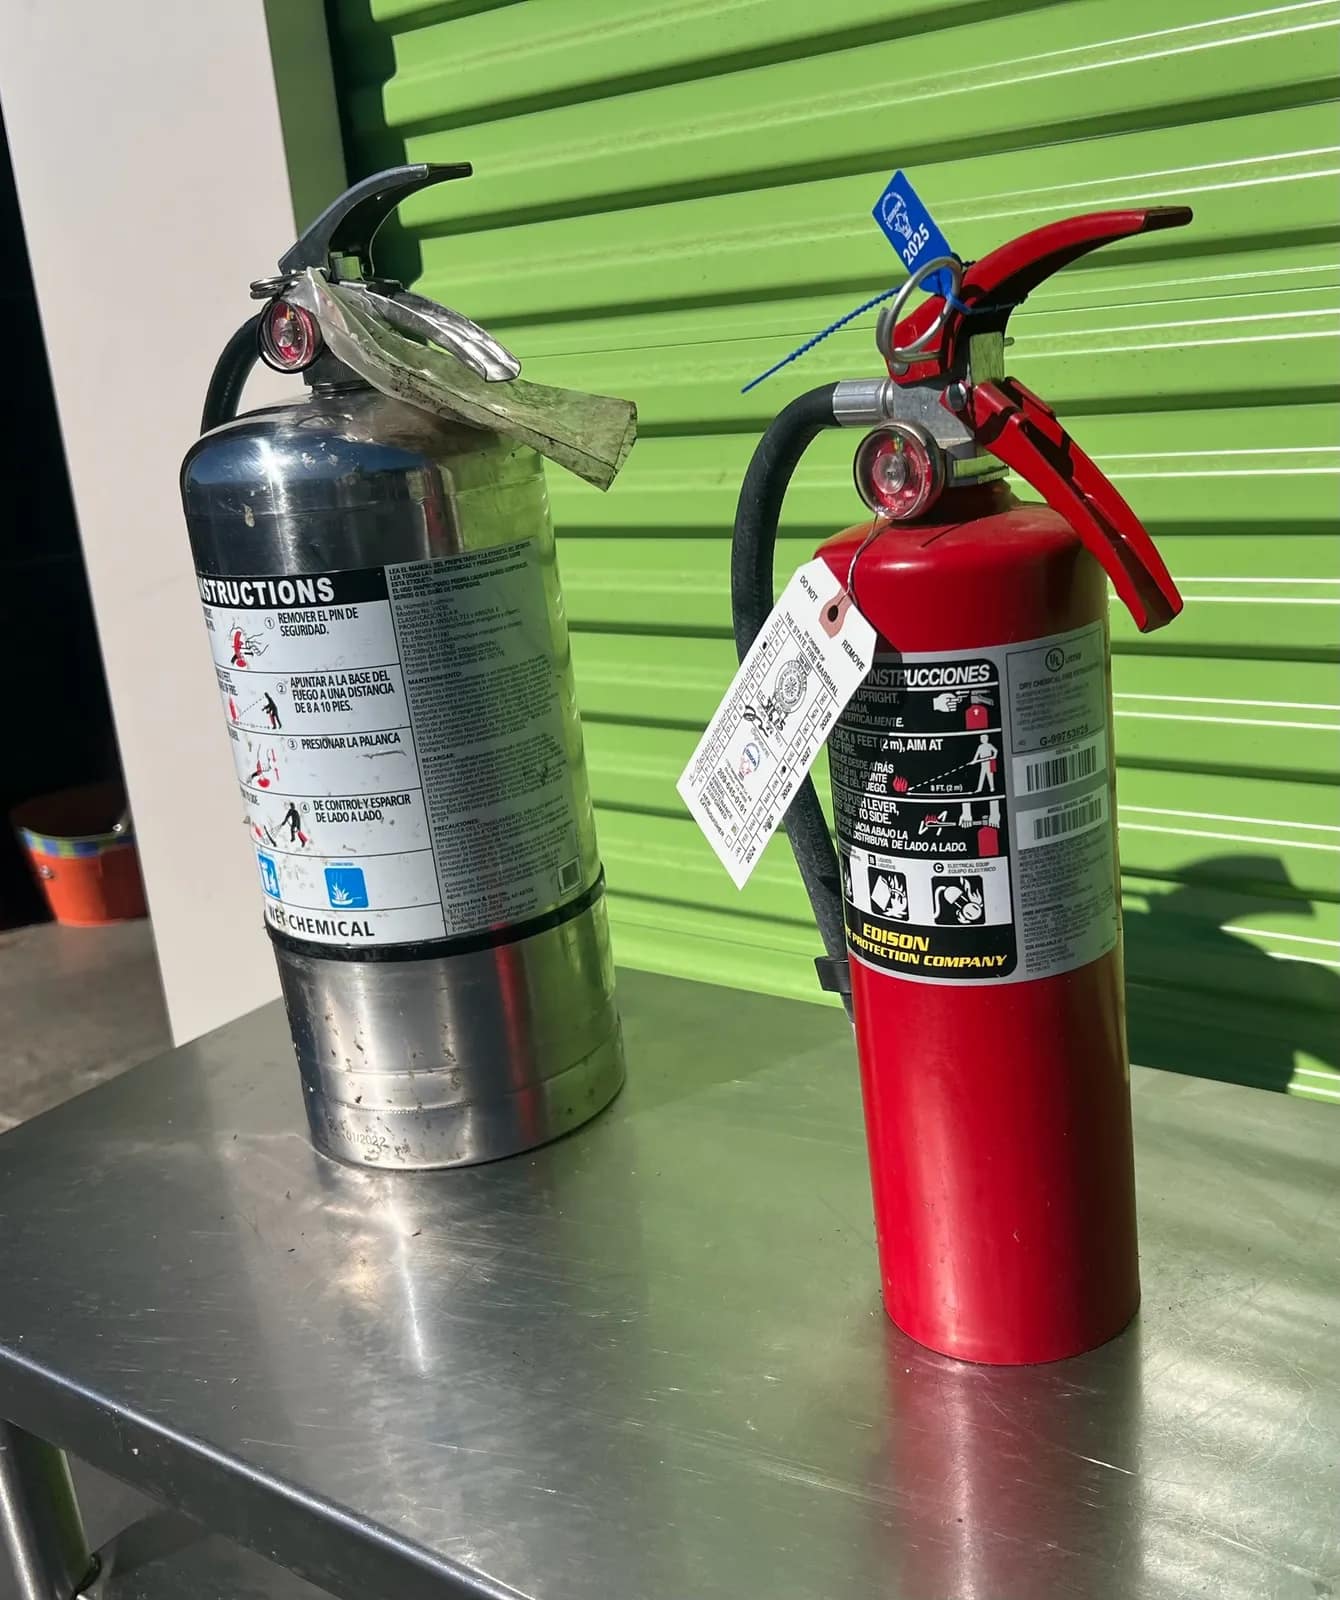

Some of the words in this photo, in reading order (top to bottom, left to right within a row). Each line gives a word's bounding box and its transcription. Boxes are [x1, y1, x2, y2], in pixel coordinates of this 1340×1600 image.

[903, 223, 930, 266] 2025
[278, 611, 317, 624] REMOVER
[318, 611, 328, 622] EL
[329, 609, 343, 621] PIN
[344, 608, 359, 619] DE
[800, 575, 809, 588] DO
[805, 585, 819, 602] NOT
[842, 640, 866, 672] REMOVE
[281, 624, 330, 637] SEGURIDAD.
[784, 611, 794, 628] THE
[792, 624, 806, 648] STATE
[805, 644, 817, 664] FIRE
[815, 660, 839, 698] MARSHAL
[290, 675, 327, 688] APUNTAR
[327, 675, 335, 687] A
[335, 674, 348, 686] LA
[349, 672, 372, 685] BASE
[373, 670, 391, 682] DEL
[292, 688, 319, 700] FUEGO
[320, 688, 327, 699] A
[328, 686, 347, 698] UNA
[348, 682, 395, 697] DISTANCIA
[857, 690, 900, 705] UPRIGHT.
[295, 702, 306, 713] DE
[307, 701, 313, 713] 8
[313, 701, 320, 712] A
[321, 700, 331, 711] 10
[332, 699, 353, 712] PIES.
[301, 736, 345, 750] PRESIONAR
[346, 736, 358, 748] LA
[360, 733, 401, 747] PALANCA
[857, 735, 878, 748] FEET
[907, 739, 927, 751] AIM
[929, 739, 944, 751] AT
[799, 746, 811, 767] 2027
[313, 800, 324, 811] DE
[325, 799, 361, 811] CONTROL
[370, 794, 411, 809] ESPARCIR
[867, 798, 900, 816] LEVER,
[316, 812, 327, 823] DE
[327, 811, 350, 823] LADO
[351, 811, 358, 822] A
[871, 826, 896, 839] ABAJO
[897, 830, 909, 840] LA
[892, 840, 904, 849] DE
[904, 841, 929, 851] LADO
[930, 841, 937, 852] A
[938, 842, 967, 852] LADO.
[288, 914, 376, 938] CHEMICAL
[863, 923, 930, 952] EDISON
[853, 932, 920, 965] PROTECTION
[923, 954, 1007, 968] COMPANY
